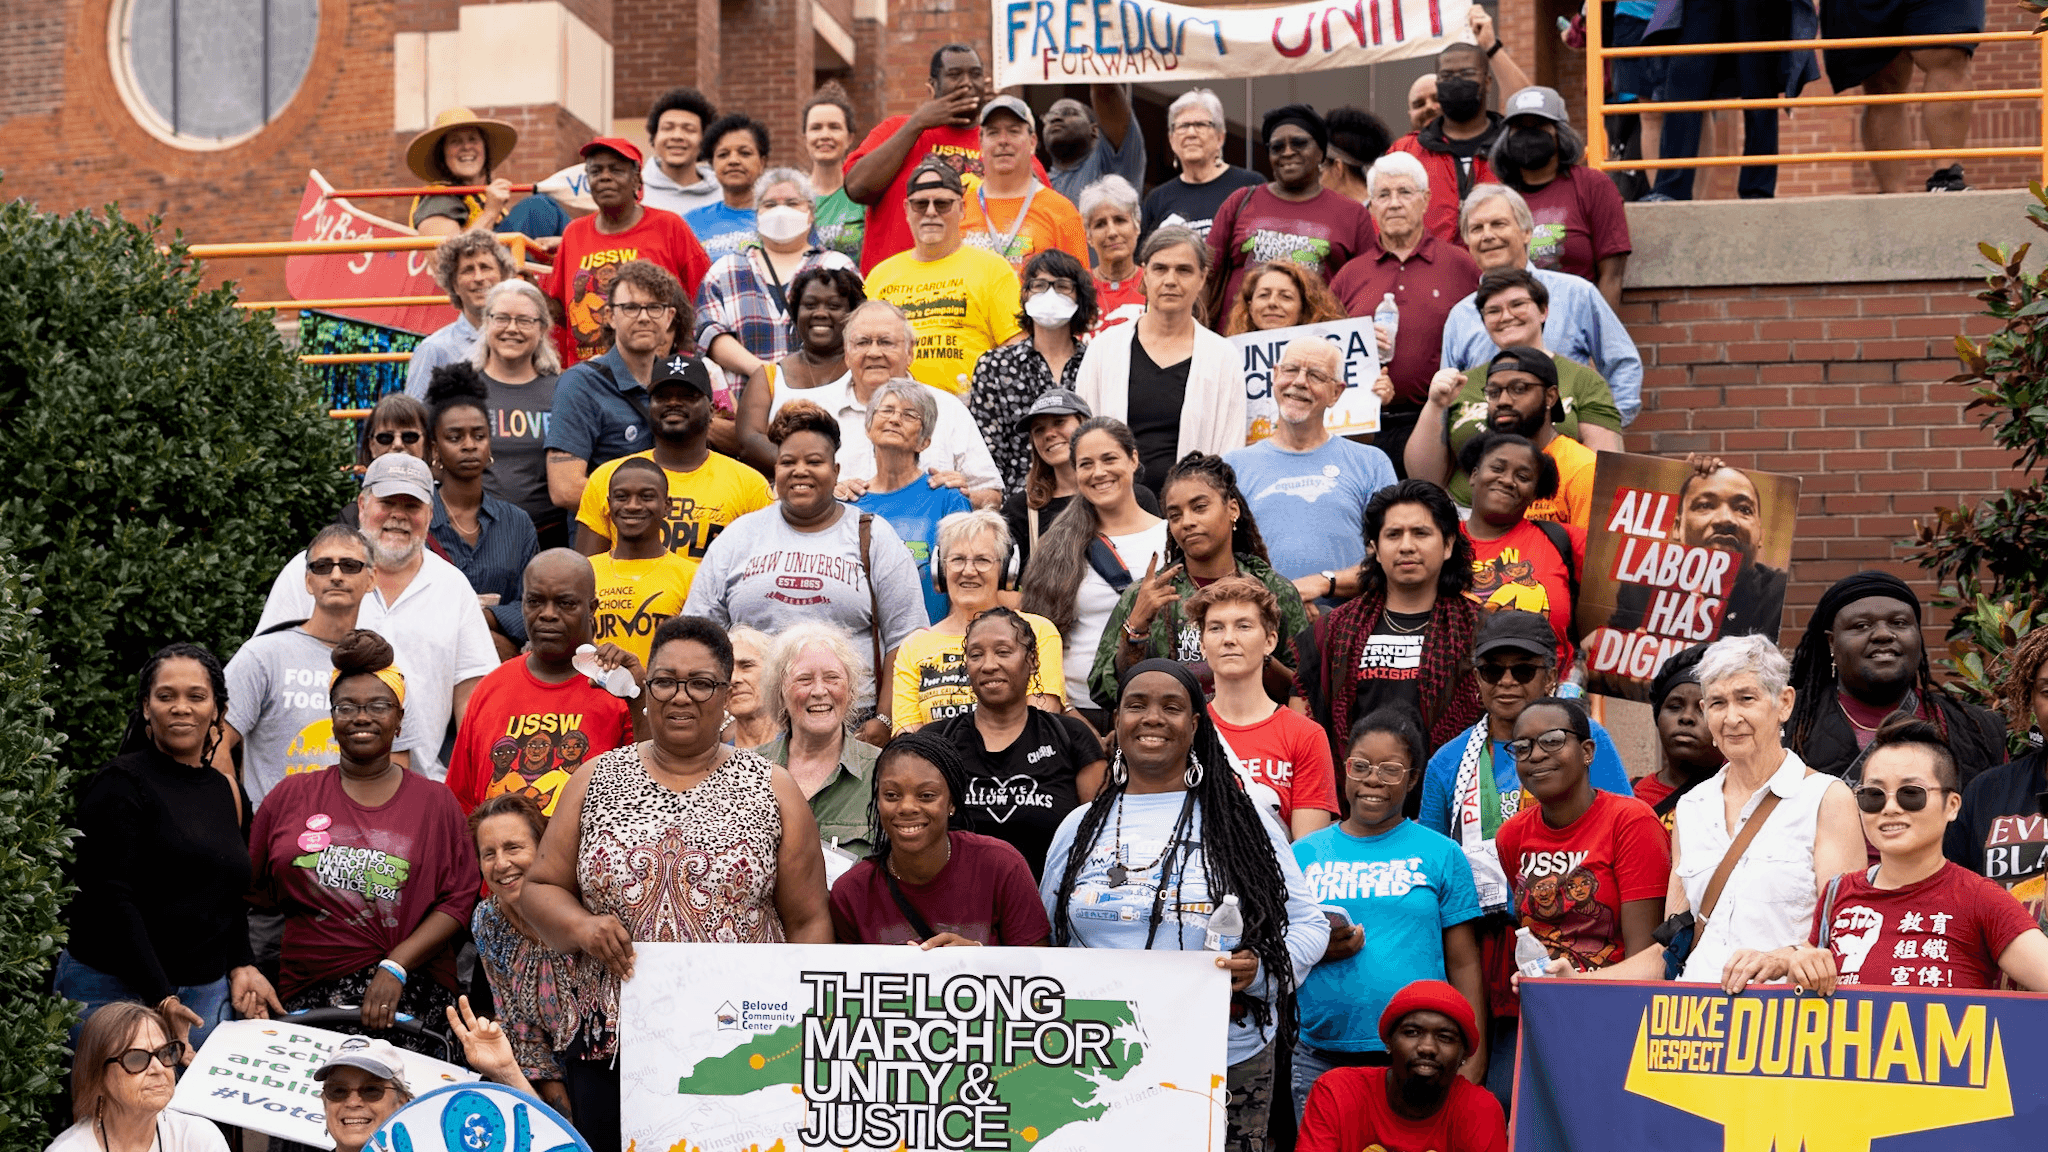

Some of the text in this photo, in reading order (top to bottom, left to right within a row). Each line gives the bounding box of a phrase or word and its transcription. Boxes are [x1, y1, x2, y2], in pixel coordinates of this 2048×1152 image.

[1043, 45, 1178, 79] FORWARD
[580, 249, 637, 271] USSW
[880, 278, 964, 295] NORTH CAROLINA
[924, 306, 965, 317] Campaign
[945, 335, 958, 346] BE
[915, 348, 964, 360] ANYMORE
[1608, 490, 1669, 539] ALL
[785, 552, 859, 592] UNIVERSITY
[1616, 537, 1731, 596] LABOR
[778, 577, 820, 589] EST. 1865
[1646, 590, 1720, 641] HAS
[1593, 627, 1698, 681] DIGN
[505, 712, 583, 739] USSW
[1266, 759, 1293, 782] UP
[1014, 793, 1054, 809] OAKS
[319, 852, 396, 878] MARCH FOR
[348, 847, 387, 863] LONG
[1520, 849, 1589, 879] USSW
[316, 862, 355, 879] UNITY
[370, 882, 397, 901] 2024
[1310, 880, 1411, 904] UNITED
[1897, 910, 1954, 935] 教育
[1892, 938, 1950, 962] 組織
[1889, 965, 1954, 988] 宣傳!
[742, 1000, 788, 1011] Beloved
[800, 971, 1066, 1022] THE LONG
[742, 1011, 795, 1023] Community
[742, 1021, 773, 1031] Center
[1652, 994, 1728, 1038] DUKE
[802, 1013, 1118, 1069] MARCH FOR
[1724, 996, 1987, 1087] DURHAM
[227, 1053, 292, 1074] are
[1648, 1038, 1724, 1073] RESPECT
[803, 1059, 1000, 1107] UNITY &
[797, 1101, 1010, 1151] JUSTICE
